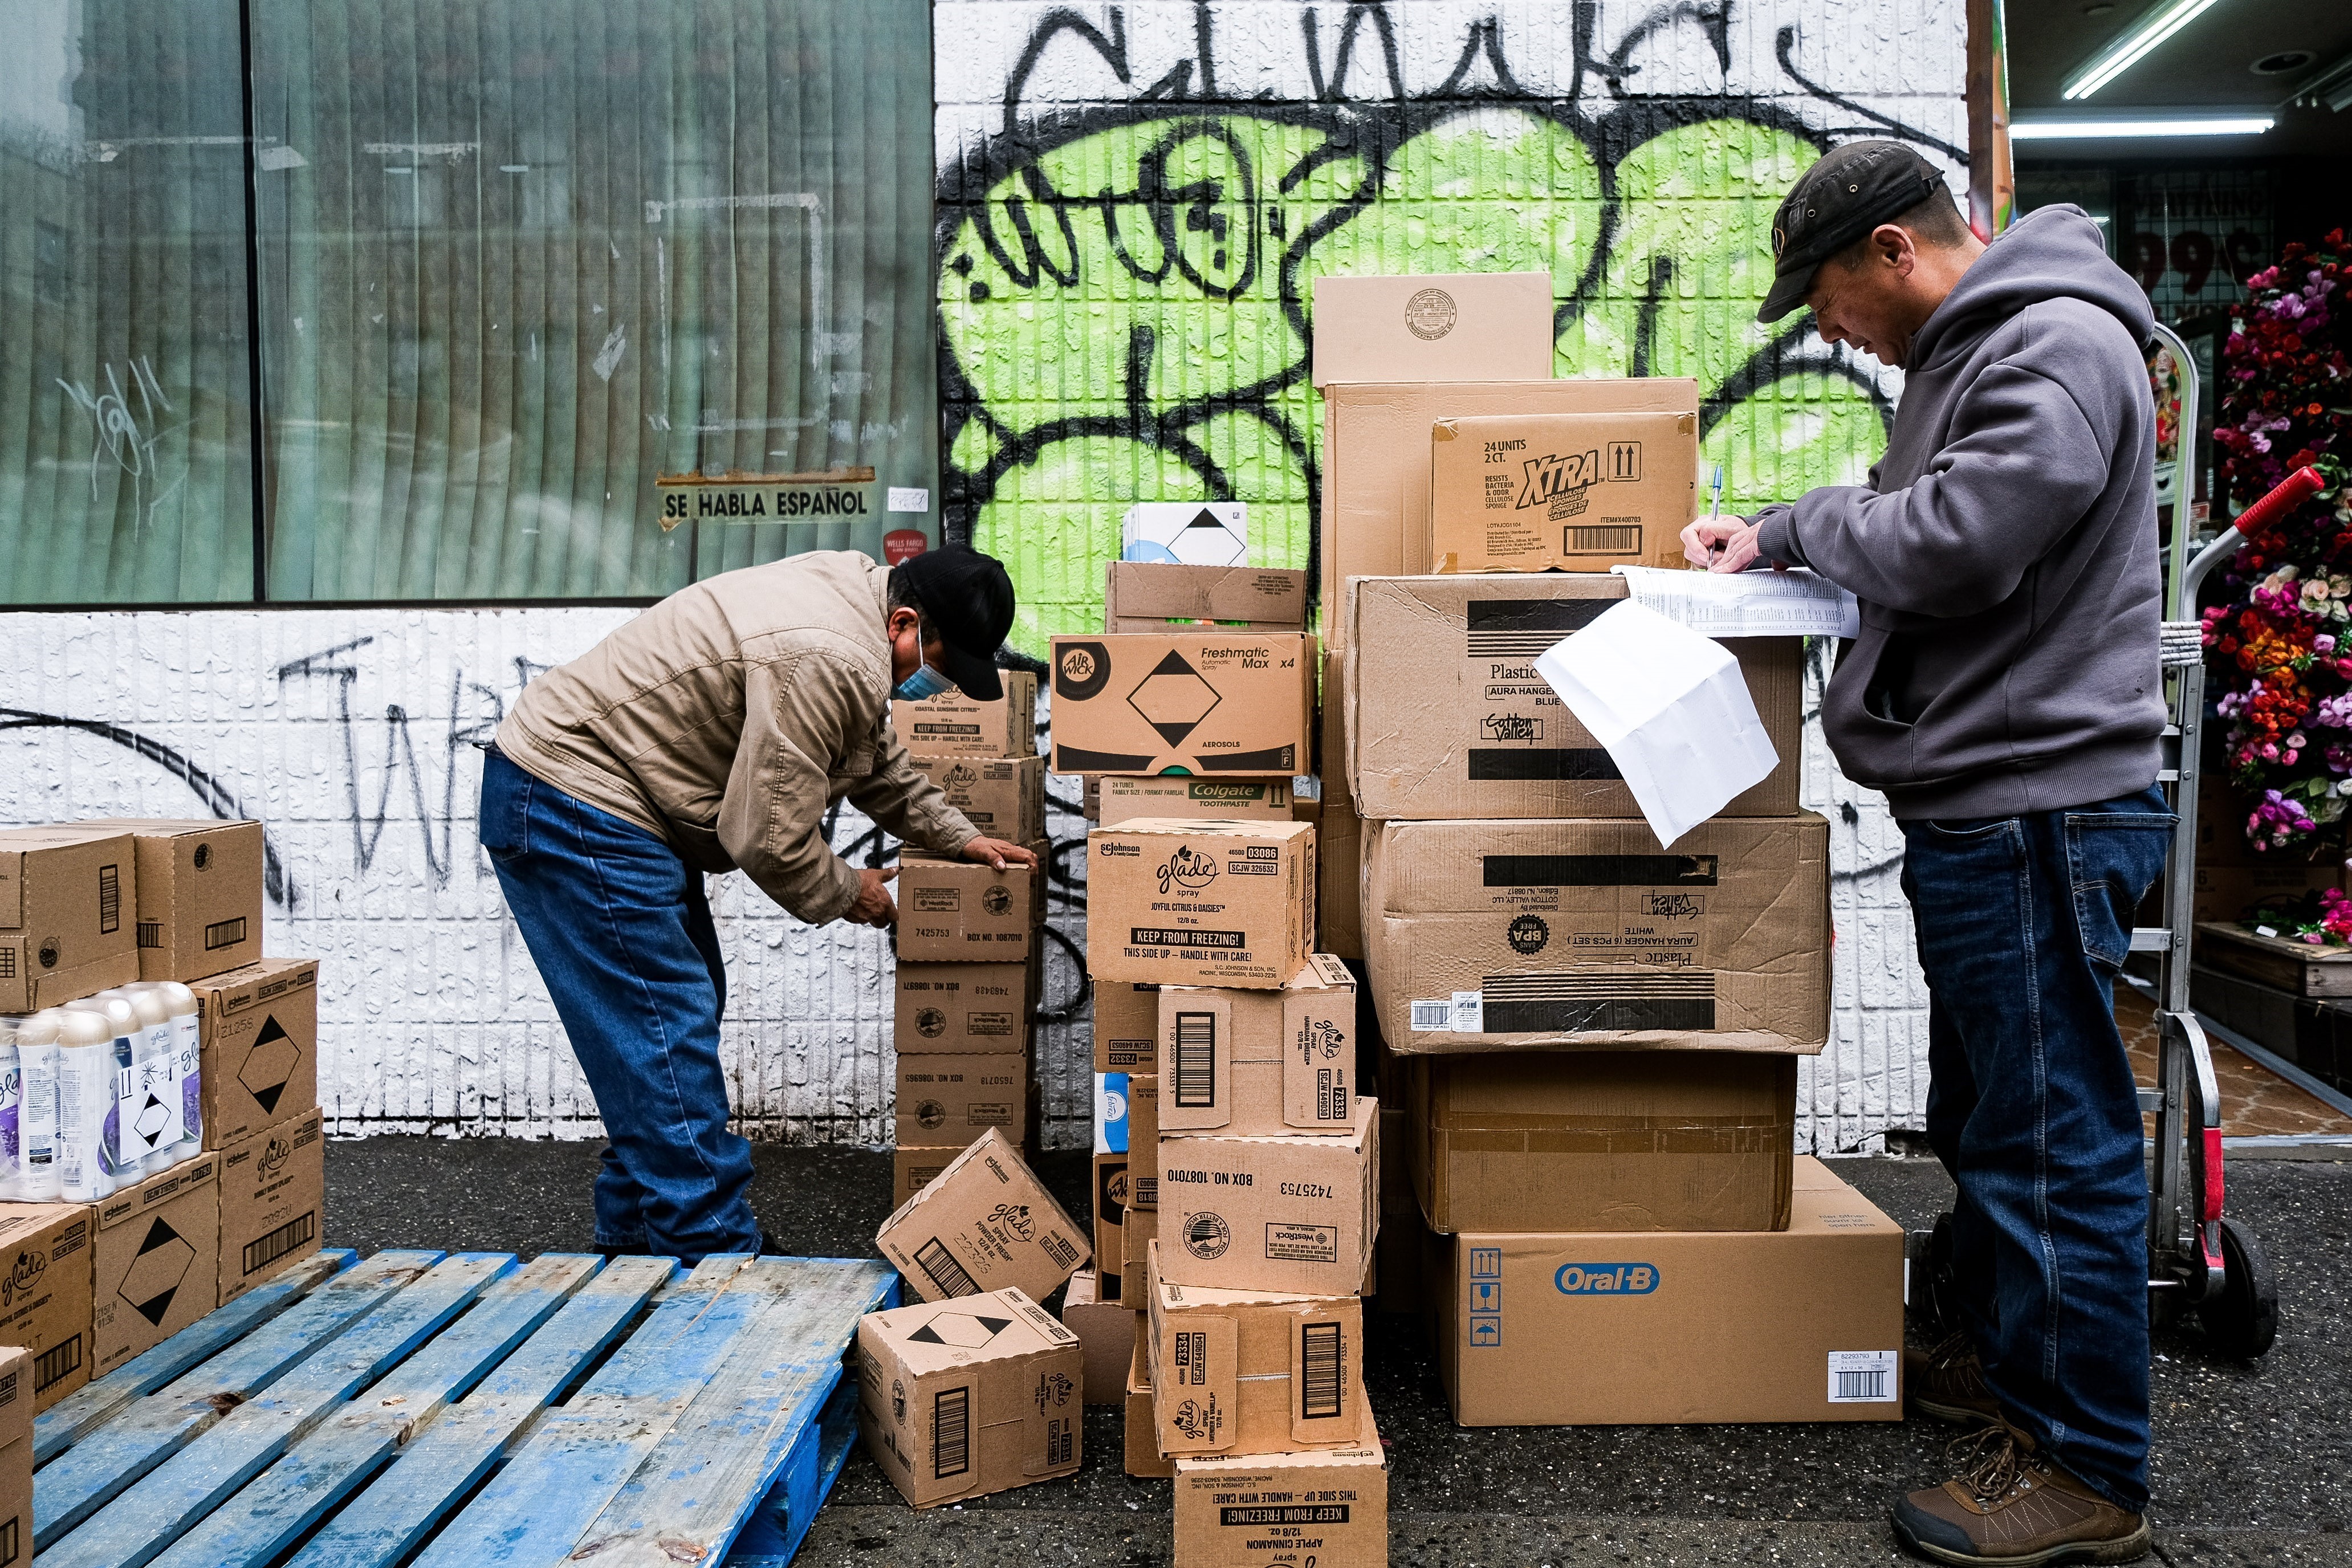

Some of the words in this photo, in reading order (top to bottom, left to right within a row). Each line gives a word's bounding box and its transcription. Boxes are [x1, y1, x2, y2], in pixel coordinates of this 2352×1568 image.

[1409, 322, 1432, 339] PACKAGING
[1484, 443, 1496, 451] 24
[1498, 439, 1526, 451] UNITS
[1492, 453, 1506, 462] CT.
[1515, 449, 1598, 510] XTRA
[1549, 487, 1586, 501] CELLULOSE
[1553, 494, 1582, 506] SPONGES
[666, 494, 687, 518] SE
[699, 492, 766, 517] HABLA
[777, 487, 867, 514] ESPAÑOL
[1549, 503, 1577, 515] ÉPONGES
[1549, 508, 1585, 520] CELLULOSE
[1202, 647, 1269, 658] Freshmatic
[1063, 665, 1093, 675] WICK
[1242, 658, 1269, 669] Max
[1280, 658, 1295, 669] x4
[1491, 664, 1537, 679] Plastic
[1486, 713, 1533, 728] Cotton
[1494, 722, 1533, 745] Valley
[943, 767, 978, 792] glade
[1194, 784, 1254, 796] Colgate
[1248, 849, 1276, 858] 03086
[1157, 852, 1220, 894] glade
[1651, 889, 1690, 911] Valley
[1653, 907, 1698, 921] Cotton
[916, 928, 949, 937] 7425753
[1138, 932, 1160, 943] KEEP
[1163, 933, 1188, 944] FROM
[1192, 934, 1238, 946] FREEZING!
[1513, 930, 1541, 940] BPA
[1614, 935, 1622, 944] (6
[1124, 948, 1140, 958] THIS
[1142, 949, 1157, 958] SIDE
[1159, 950, 1170, 959] UP
[1181, 951, 1208, 960] HANDLE
[1210, 952, 1229, 961] WITH
[1645, 952, 1692, 966] Plastic
[1315, 1020, 1342, 1060] glade
[1106, 1094, 1117, 1118] febreze
[1335, 1089, 1344, 1118] 73333
[258, 1139, 291, 1182] glade
[193, 1165, 210, 1180] 01793
[1168, 1170, 1208, 1183] 1087010
[1211, 1172, 1229, 1185] NO.
[1232, 1174, 1253, 1186] BOX
[1280, 1182, 1332, 1198] 7425753
[987, 1203, 1036, 1243] glade
[1199, 1214, 1219, 1223] BETTER
[67, 1223, 84, 1239] 03086
[1185, 1216, 1199, 1235] WORLD
[975, 1220, 996, 1245] POWDER
[992, 1226, 1010, 1245] SPRAY
[1275, 1232, 1314, 1241] WestRock
[1186, 1240, 1210, 1257] WORKING
[1211, 1242, 1227, 1257] PEOPLE
[2, 1251, 48, 1307] glade
[1560, 1266, 1652, 1291] Oral-B
[1178, 1334, 1188, 1364] 73334
[1049, 1372, 1071, 1408] glade
[1177, 1398, 1205, 1439] glade
[1213, 1493, 1236, 1504] CARE!
[1239, 1492, 1259, 1503] WITH
[1262, 1492, 1293, 1502] HANDLE
[1304, 1491, 1315, 1501] UP
[1318, 1491, 1336, 1501] SIDE
[1338, 1490, 1357, 1500] THIS
[1228, 1509, 1280, 1522] FREEZING!
[1285, 1508, 1312, 1521] FROM
[1317, 1508, 1342, 1521] KEEP
[1283, 1527, 1301, 1537] 12/8
[1247, 1539, 1293, 1549] CINNAMON
[1295, 1538, 1323, 1548] APPLE
